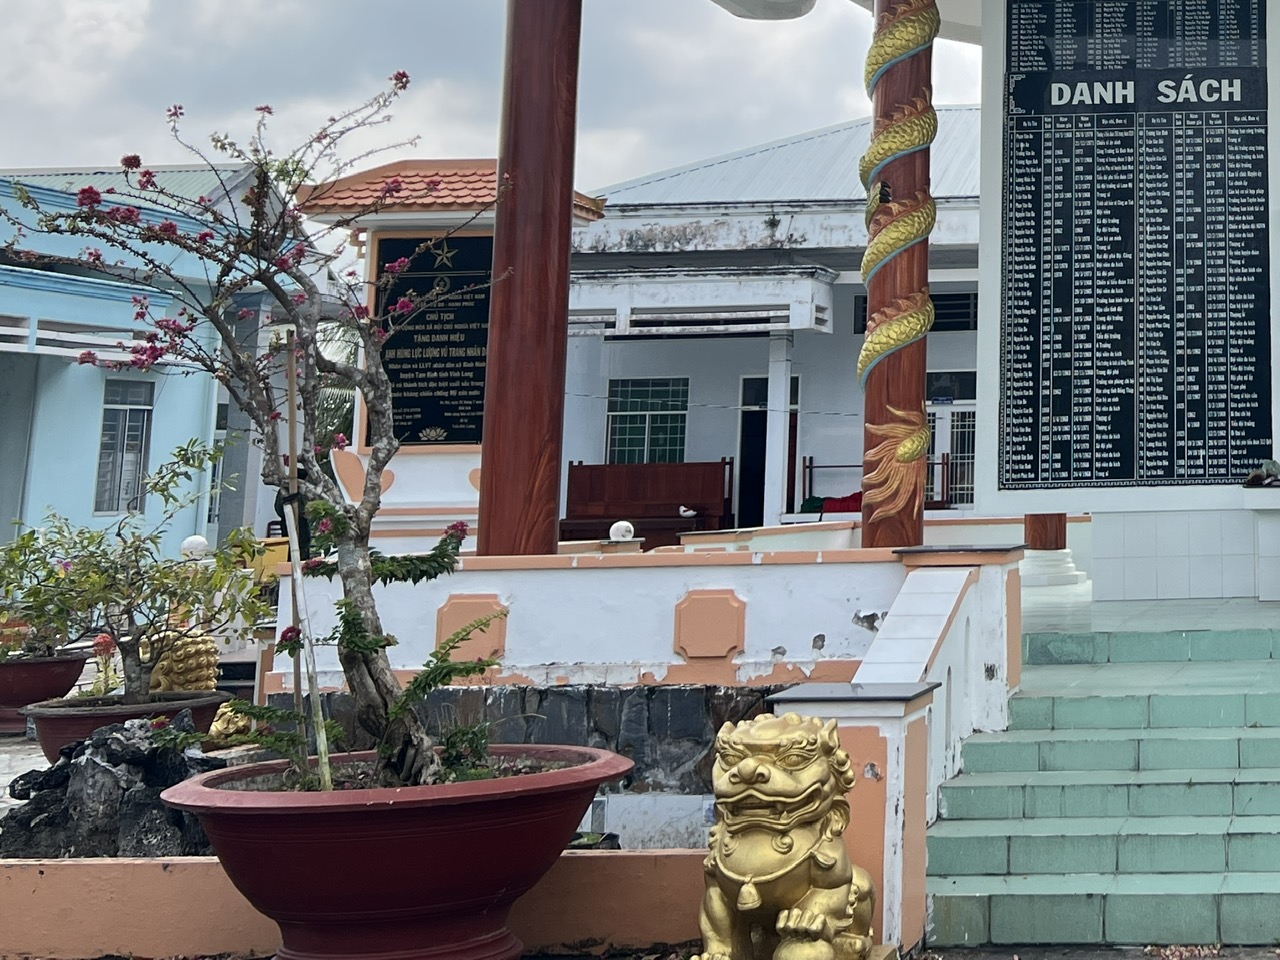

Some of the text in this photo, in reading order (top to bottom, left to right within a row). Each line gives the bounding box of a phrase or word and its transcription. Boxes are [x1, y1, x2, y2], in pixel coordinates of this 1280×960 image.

[1051, 74, 1241, 106] DANH SÁCH
[426, 311, 455, 322] CHỦ TỊCH
[413, 331, 465, 344] TẶNG DANH HIỆU
